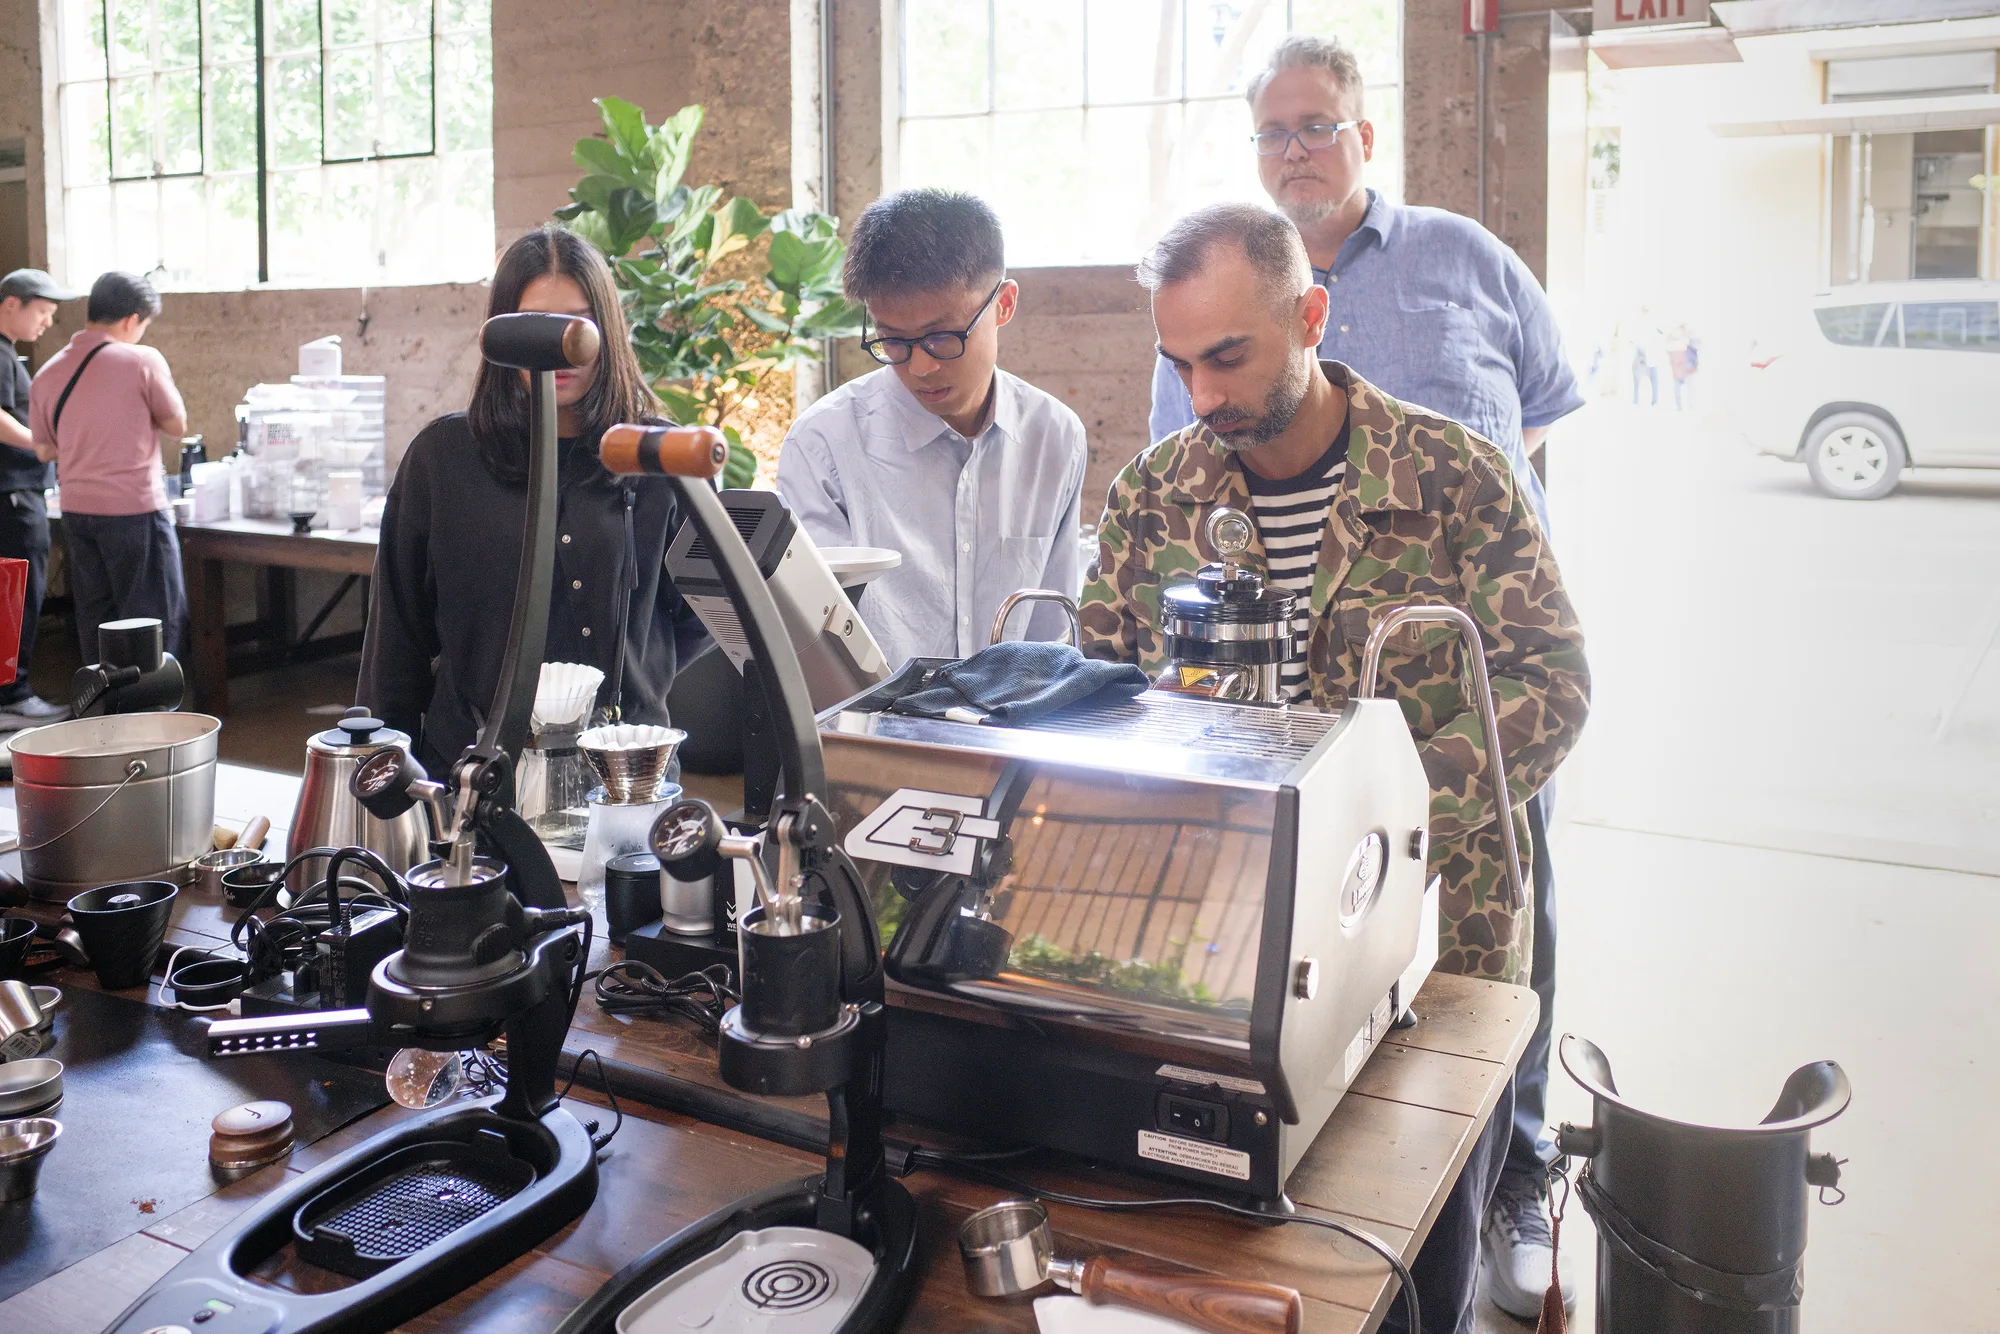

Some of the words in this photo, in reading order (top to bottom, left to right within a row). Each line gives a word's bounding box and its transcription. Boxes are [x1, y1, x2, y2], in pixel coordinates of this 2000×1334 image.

[1168, 1143, 1182, 1151] FROM
[1182, 1146, 1200, 1155] POWER
[1201, 1150, 1218, 1159] SUPPLY
[1169, 1138, 1187, 1147] BEFORE
[1188, 1142, 1212, 1152] SERVICING
[1214, 1147, 1244, 1158] DISCONNECT
[1225, 1168, 1246, 1178] SERVICE
